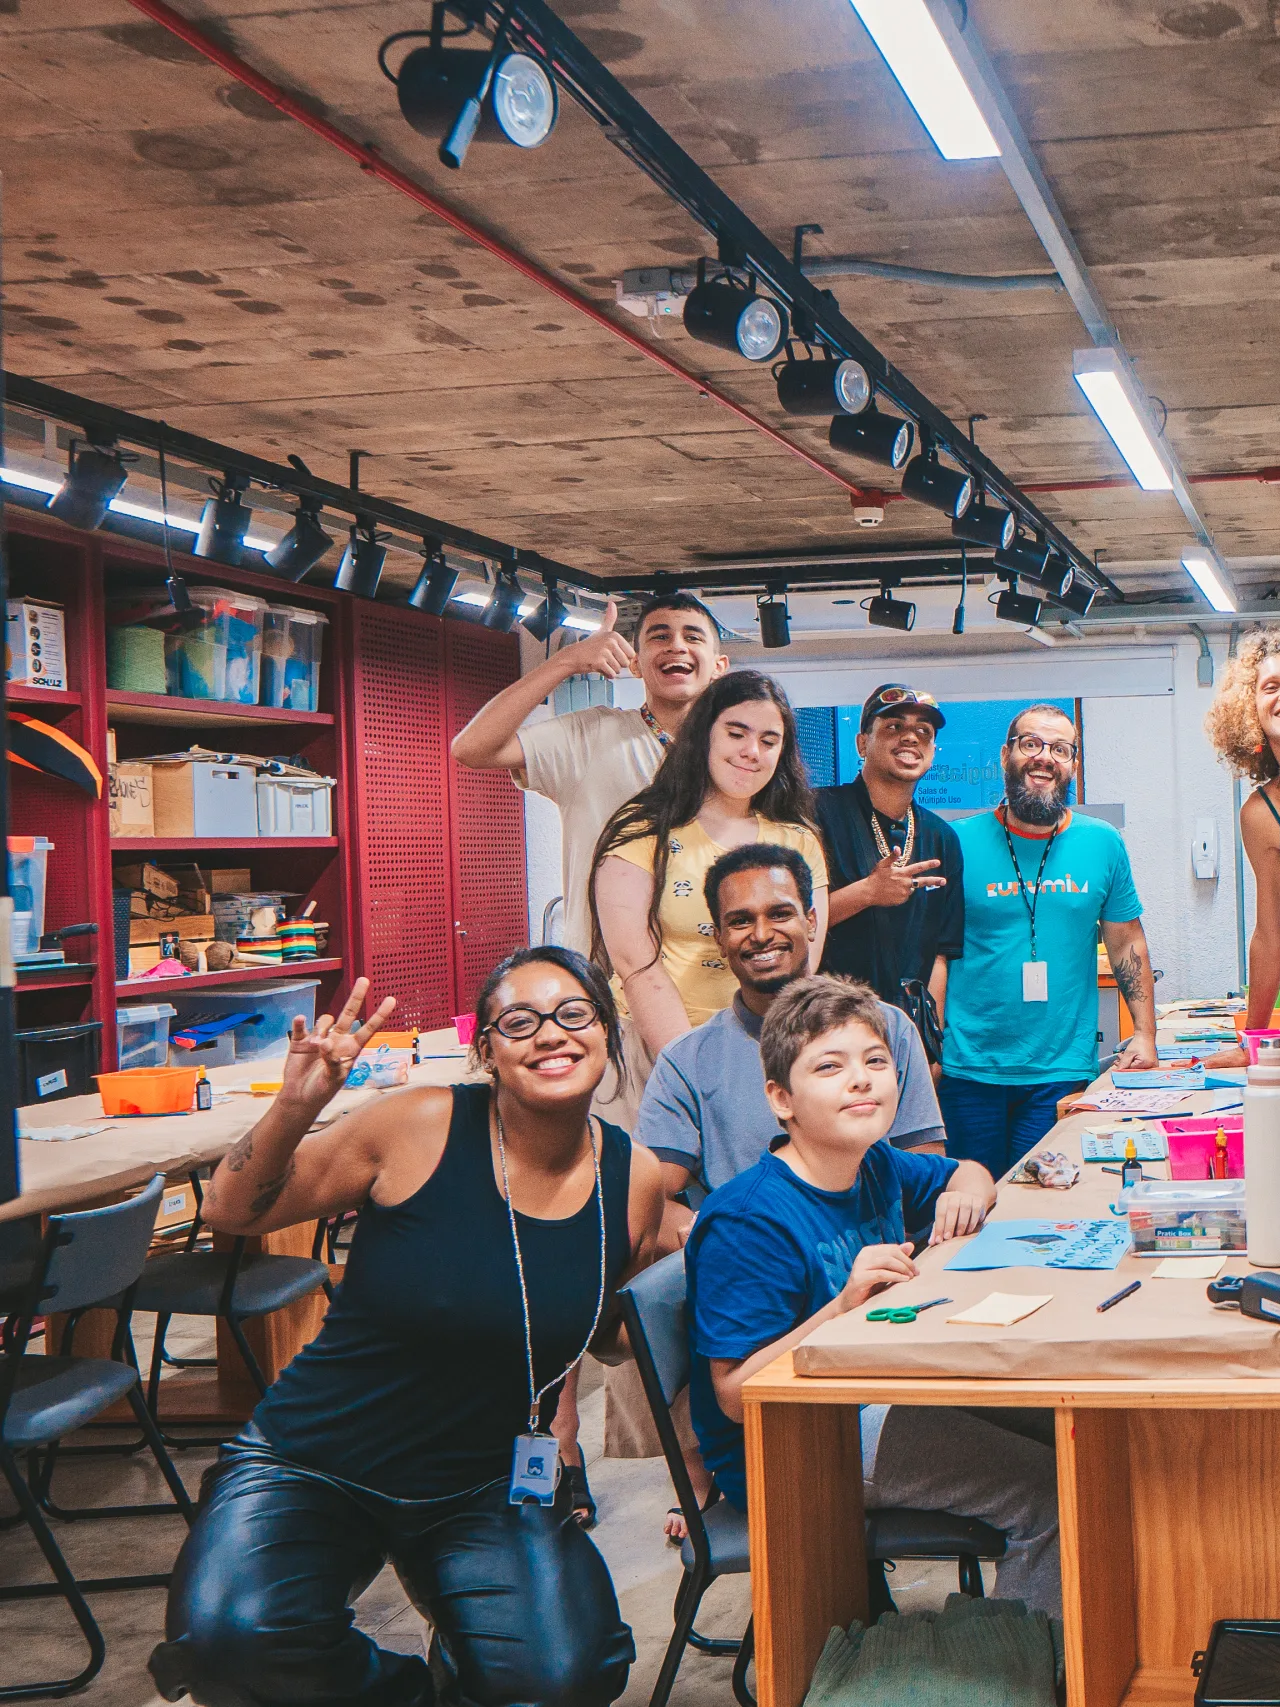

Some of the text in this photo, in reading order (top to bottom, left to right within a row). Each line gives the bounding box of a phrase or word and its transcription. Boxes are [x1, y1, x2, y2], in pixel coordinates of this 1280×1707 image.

[917, 786, 948, 795] Salas de
[948, 796, 962, 804] Uso
